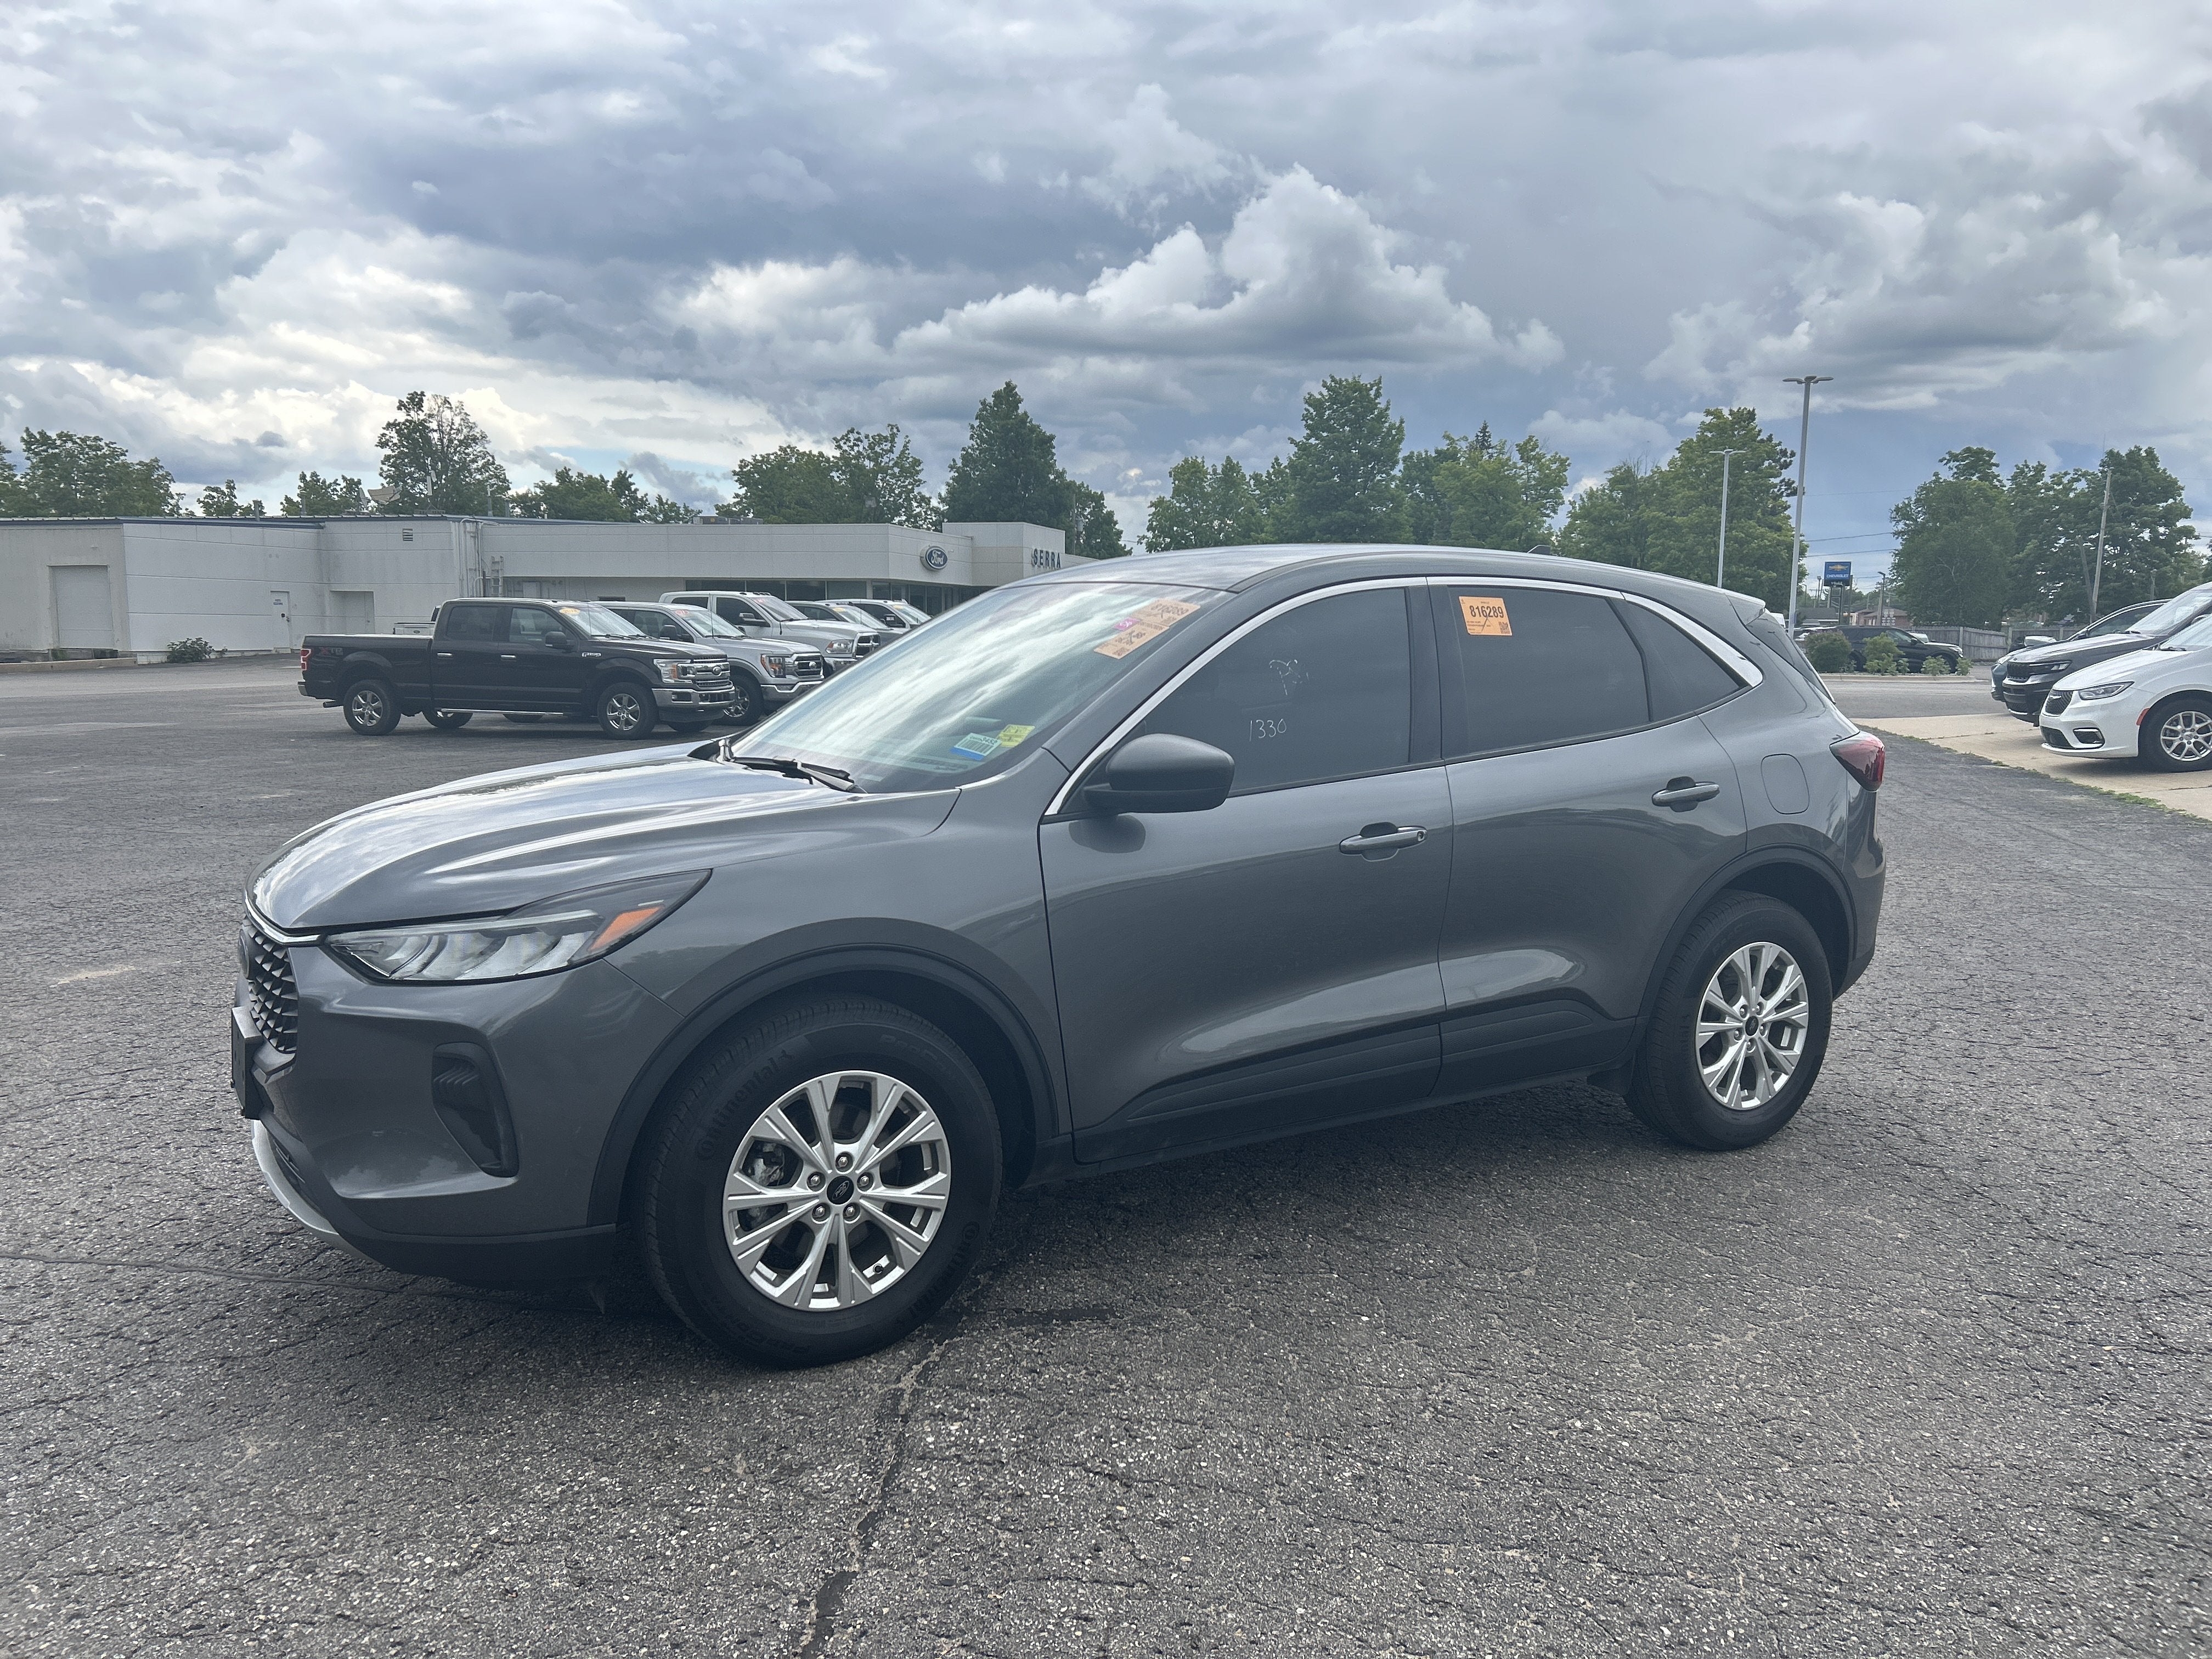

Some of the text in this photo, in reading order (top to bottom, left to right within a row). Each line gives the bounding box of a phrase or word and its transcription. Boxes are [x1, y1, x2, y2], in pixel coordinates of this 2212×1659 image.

[1033, 548, 1061, 568] SERRA
[1469, 605, 1504, 618] 816289
[1249, 718, 1287, 742] 1330
